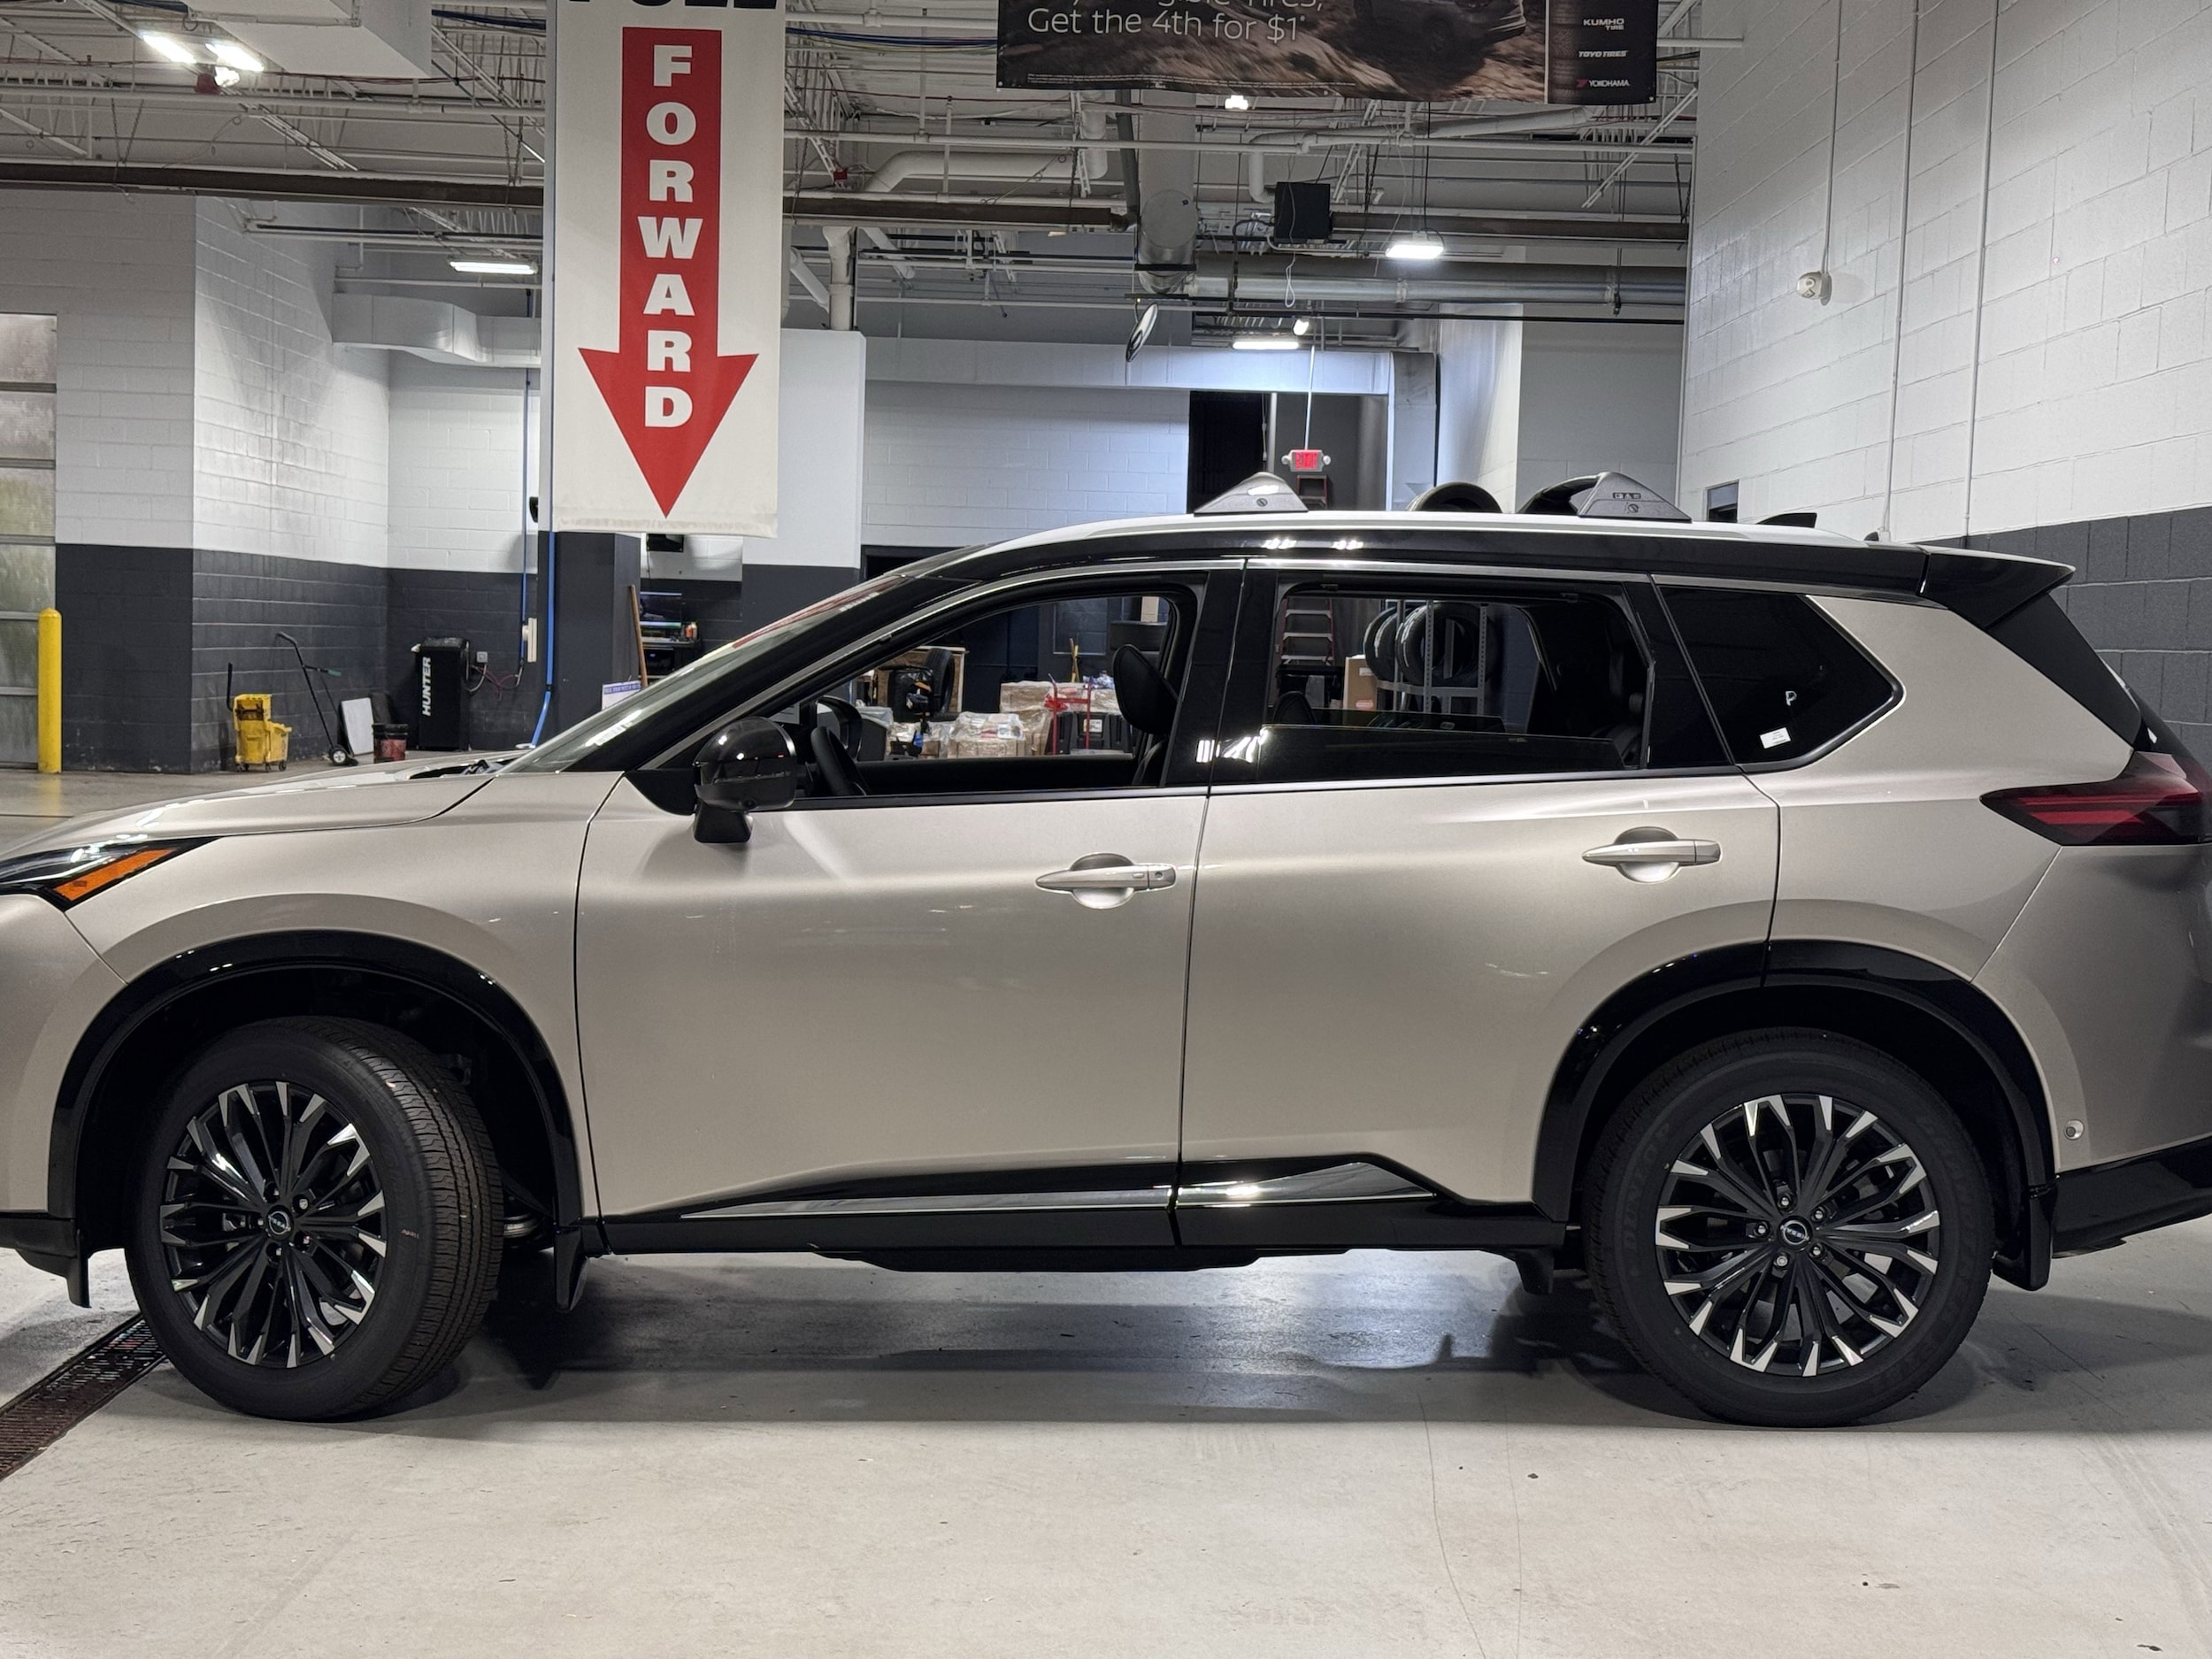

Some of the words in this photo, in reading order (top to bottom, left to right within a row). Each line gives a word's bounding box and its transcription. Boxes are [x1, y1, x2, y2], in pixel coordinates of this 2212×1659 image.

[1027, 8, 1082, 34] Get
[1092, 9, 1142, 34] the
[1152, 10, 1202, 36] 4th
[1212, 12, 1257, 40] for
[1583, 18, 1625, 27] KUMHO
[637, 44, 704, 428] FORWARD
[422, 657, 432, 717] HUNTER
[1785, 690, 1798, 706] P
